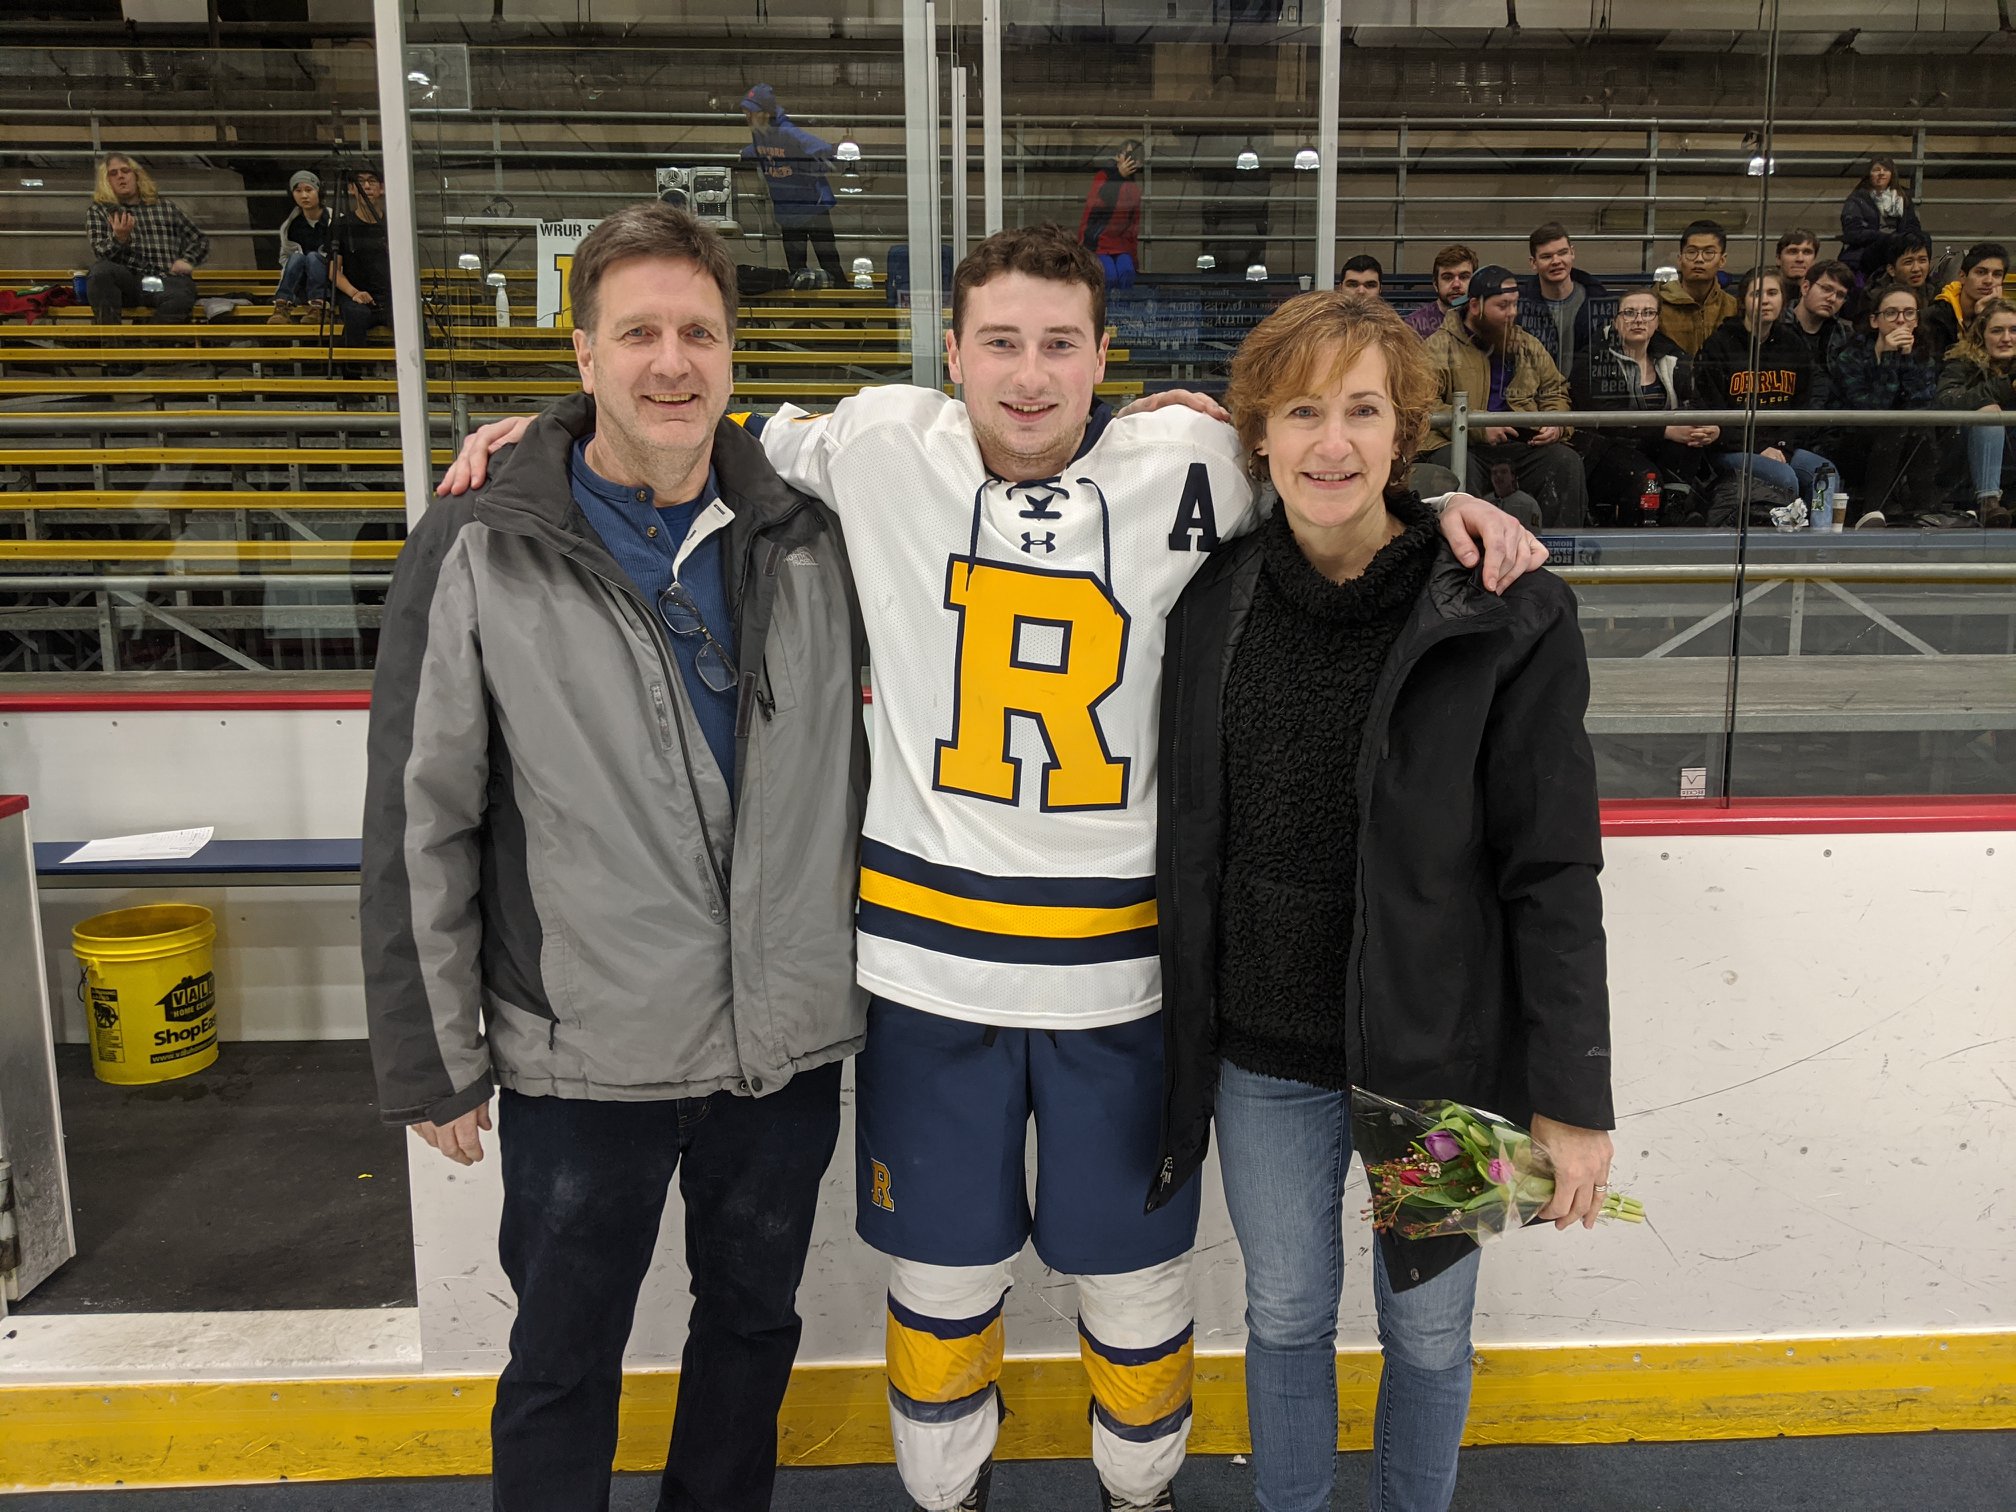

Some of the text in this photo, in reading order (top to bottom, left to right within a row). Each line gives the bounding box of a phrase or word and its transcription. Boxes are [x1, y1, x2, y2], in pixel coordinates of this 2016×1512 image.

[540, 223, 582, 237] WRUR
[1736, 395, 1789, 404] CLEGE
[1168, 462, 1221, 552] A
[932, 552, 1131, 813] R
[870, 1156, 895, 1213] R
